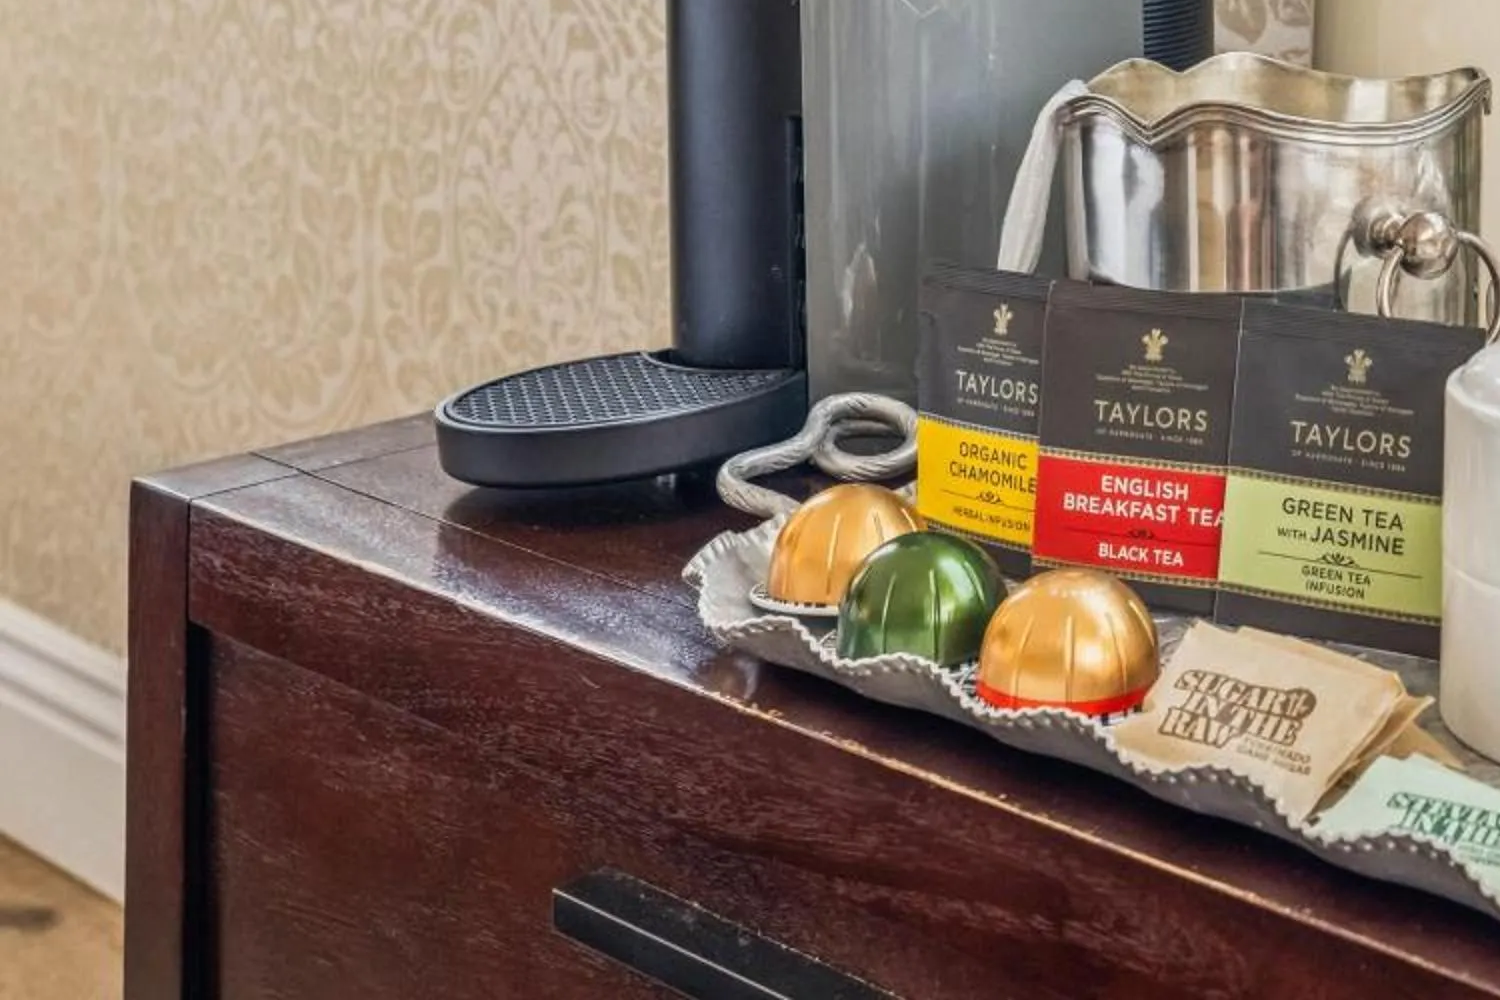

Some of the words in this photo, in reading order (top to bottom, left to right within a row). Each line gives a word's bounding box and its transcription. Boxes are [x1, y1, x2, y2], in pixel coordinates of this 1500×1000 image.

[955, 369, 1040, 405] TAYLORS
[1094, 399, 1208, 433] TAYLORS
[959, 441, 1028, 471] ORGANIC
[1290, 420, 1412, 458] TAYLORS
[948, 460, 1037, 495] CHAMOMILE
[1100, 474, 1189, 502] ENGLISH
[1062, 492, 1181, 525] BREAKFAST
[1281, 496, 1354, 524] GREEN
[1361, 508, 1404, 532] TEA
[1097, 542, 1150, 564] BLACK
[1152, 549, 1185, 568] TEA
[1277, 526, 1308, 540] WITH
[1310, 525, 1406, 556] JASMINE
[1300, 564, 1344, 582] GREEN
[1348, 571, 1371, 586] TEA
[1305, 580, 1366, 600] INFUSION
[1174, 669, 1295, 716] SUGAR
[1158, 707, 1248, 748] RAW
[1184, 690, 1228, 721] IN
[1228, 704, 1304, 746] THE
